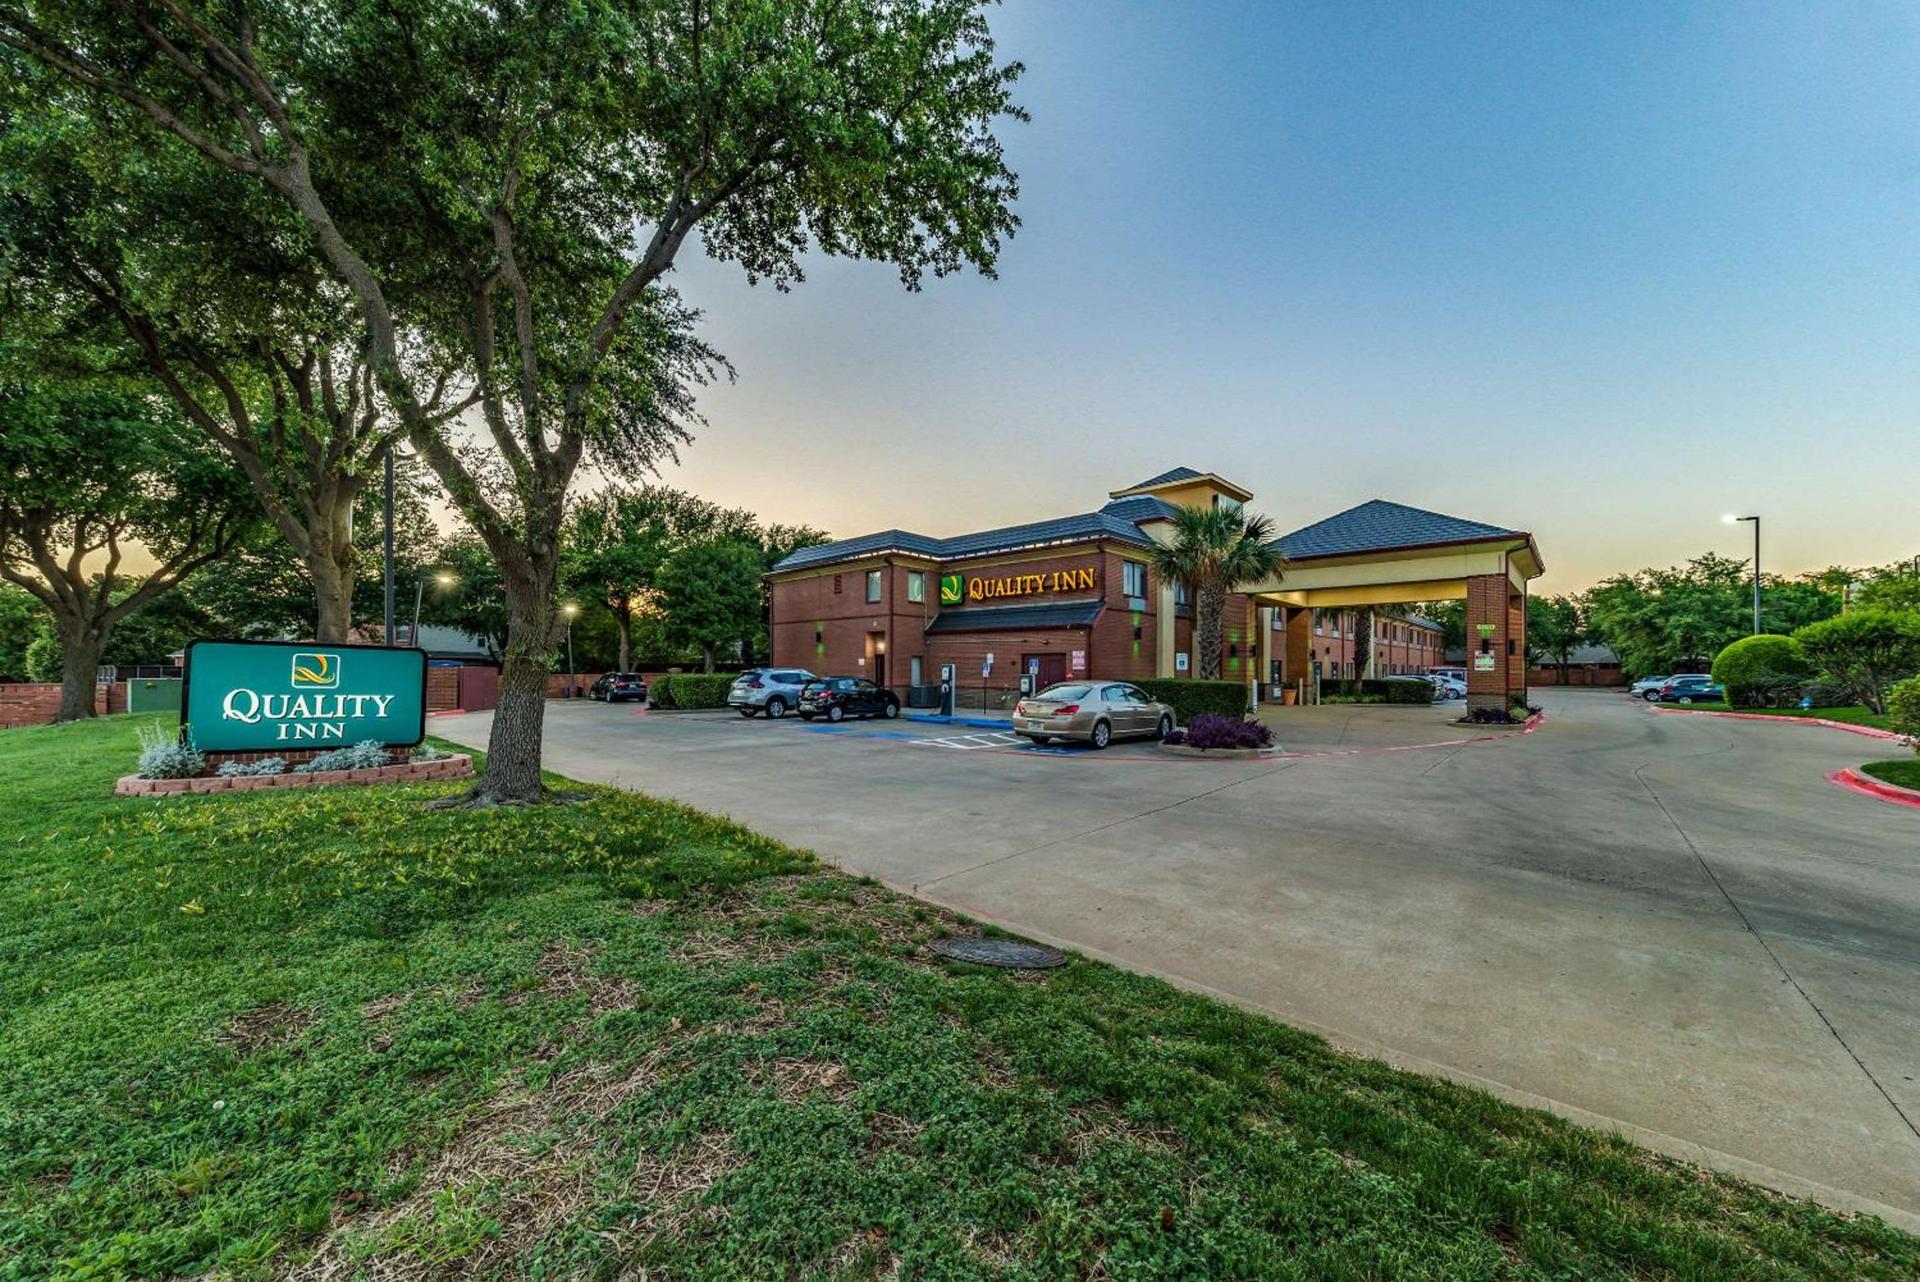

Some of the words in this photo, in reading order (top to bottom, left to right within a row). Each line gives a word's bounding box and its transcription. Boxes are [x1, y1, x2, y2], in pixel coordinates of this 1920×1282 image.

[969, 573, 1047, 600] QUALITY
[1052, 568, 1095, 591] INN
[223, 688, 395, 723] QUALITY
[277, 723, 346, 740] INN
